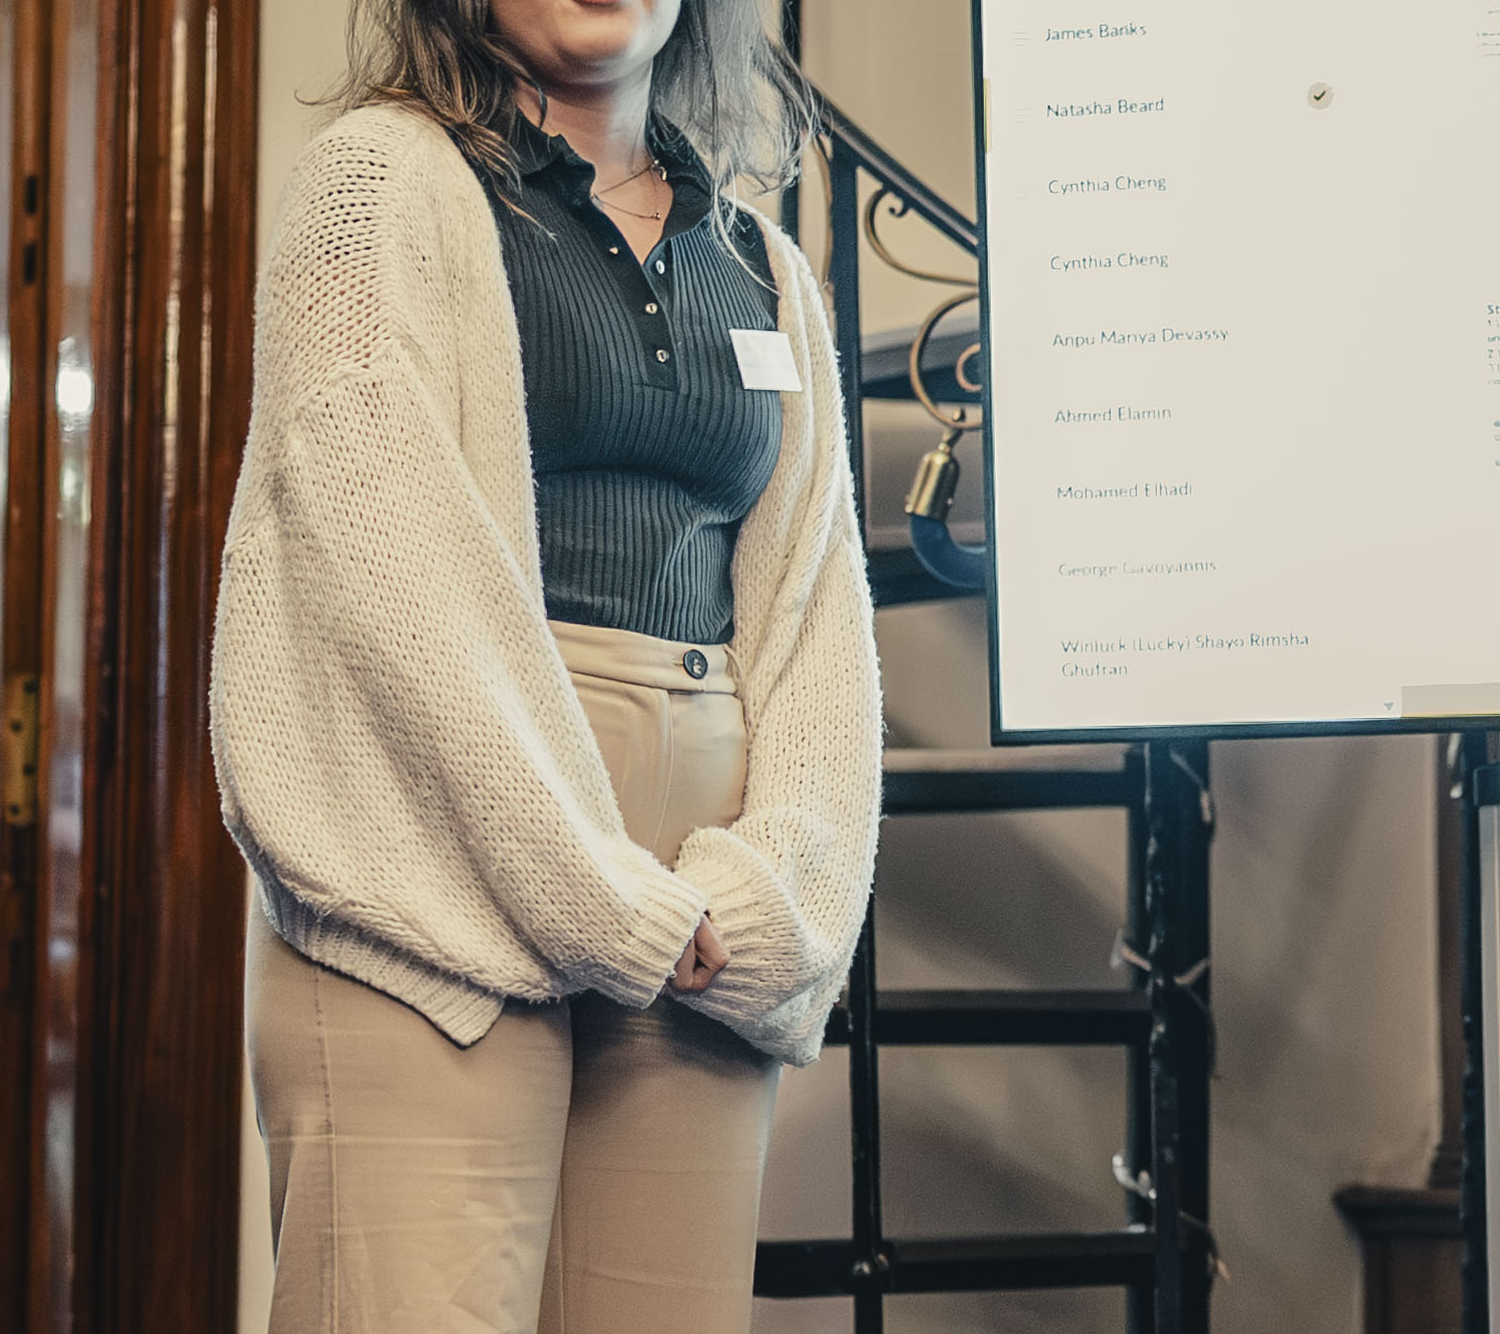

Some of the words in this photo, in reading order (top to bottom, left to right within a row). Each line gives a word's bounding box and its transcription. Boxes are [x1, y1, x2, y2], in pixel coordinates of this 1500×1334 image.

[1045, 26, 1093, 42] James
[1099, 22, 1147, 39] Banks
[1046, 101, 1112, 118] Natasha
[1118, 97, 1164, 115] Beard
[1048, 178, 1109, 196] Cynthia
[1115, 175, 1167, 193] Cheng
[1050, 254, 1111, 273] Cynthia
[1117, 251, 1169, 269] Cheng
[1162, 327, 1229, 342] Devassy
[1055, 409, 1112, 423] Ahmed
[1057, 484, 1138, 500] Mohamed
[1132, 636, 1190, 653] (Lucky)
[1249, 632, 1309, 647] Rimsha
